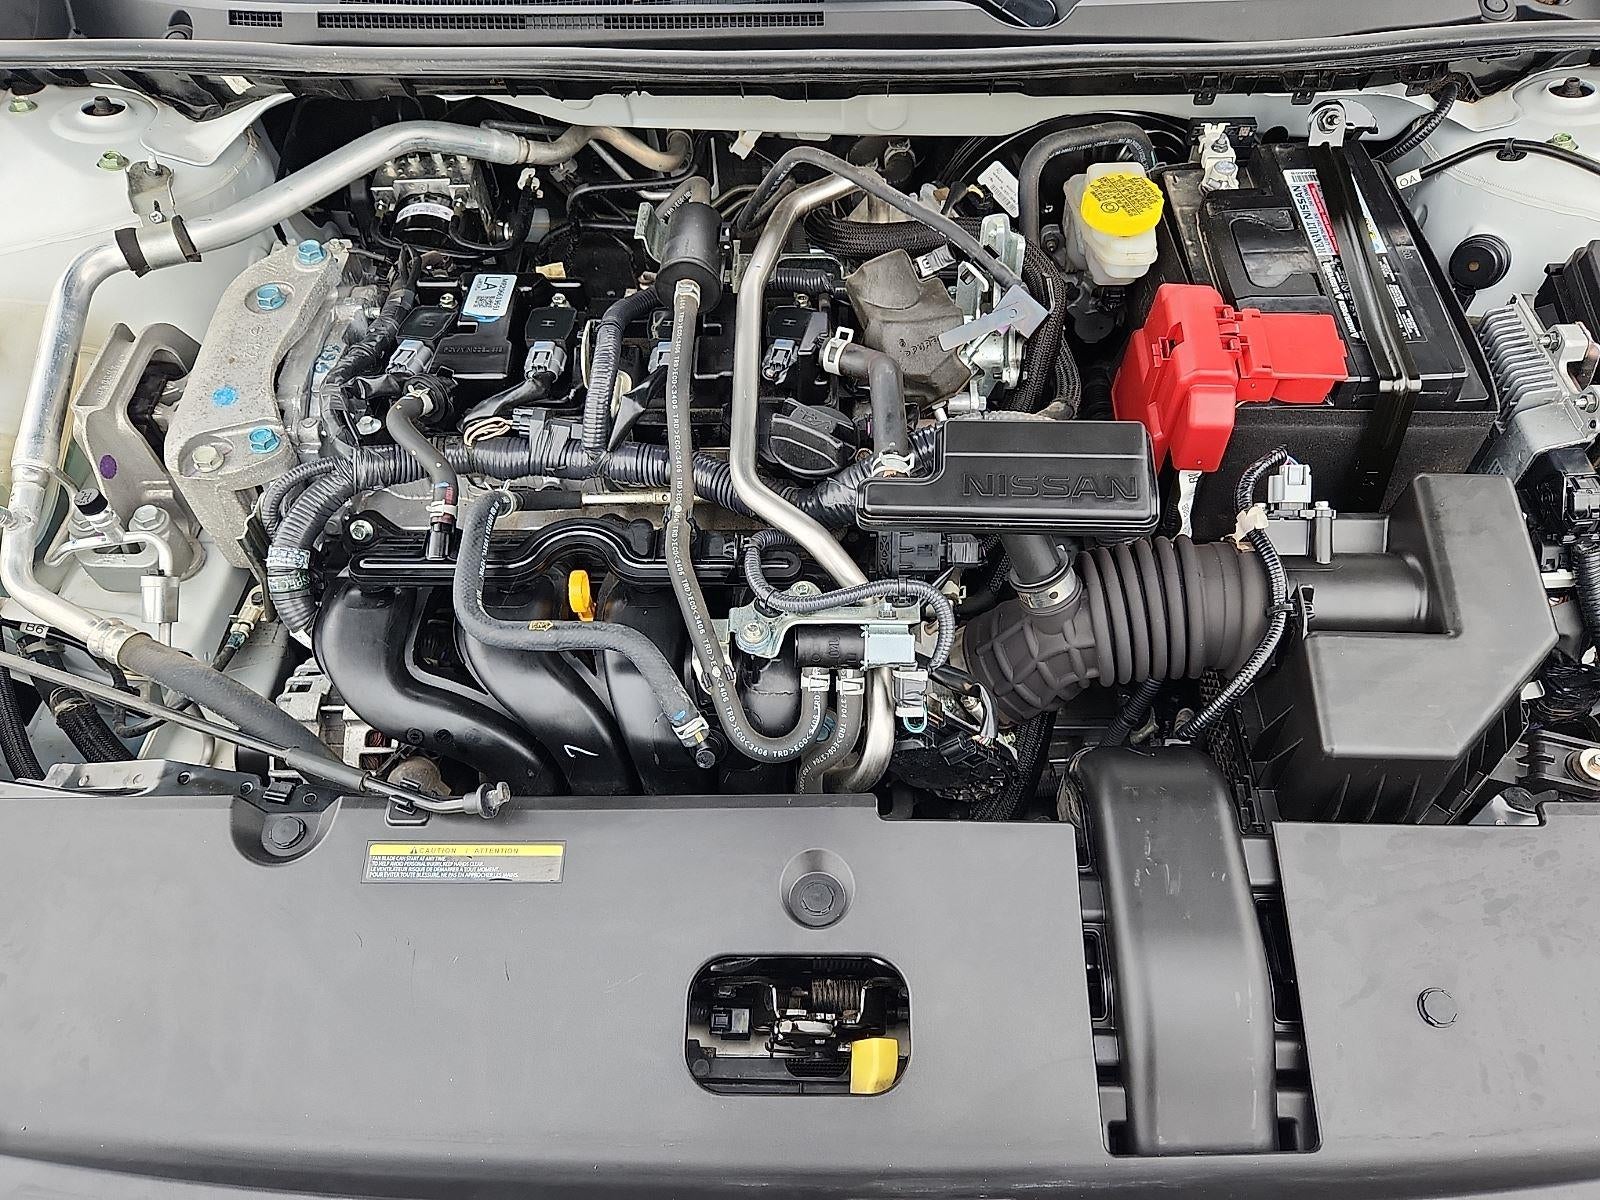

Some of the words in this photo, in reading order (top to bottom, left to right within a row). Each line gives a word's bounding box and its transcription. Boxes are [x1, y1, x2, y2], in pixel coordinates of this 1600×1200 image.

[1291, 184, 1314, 220] NISSAN
[1306, 221, 1326, 254] RENAULT
[481, 276, 502, 291] LA
[673, 413, 683, 474] TRD>ECO<3406
[962, 473, 1138, 499] NISSAN
[681, 579, 706, 635] TRD>ECO<3406
[25, 623, 45, 635] B6
[725, 705, 768, 757] TRD>ECO<3406
